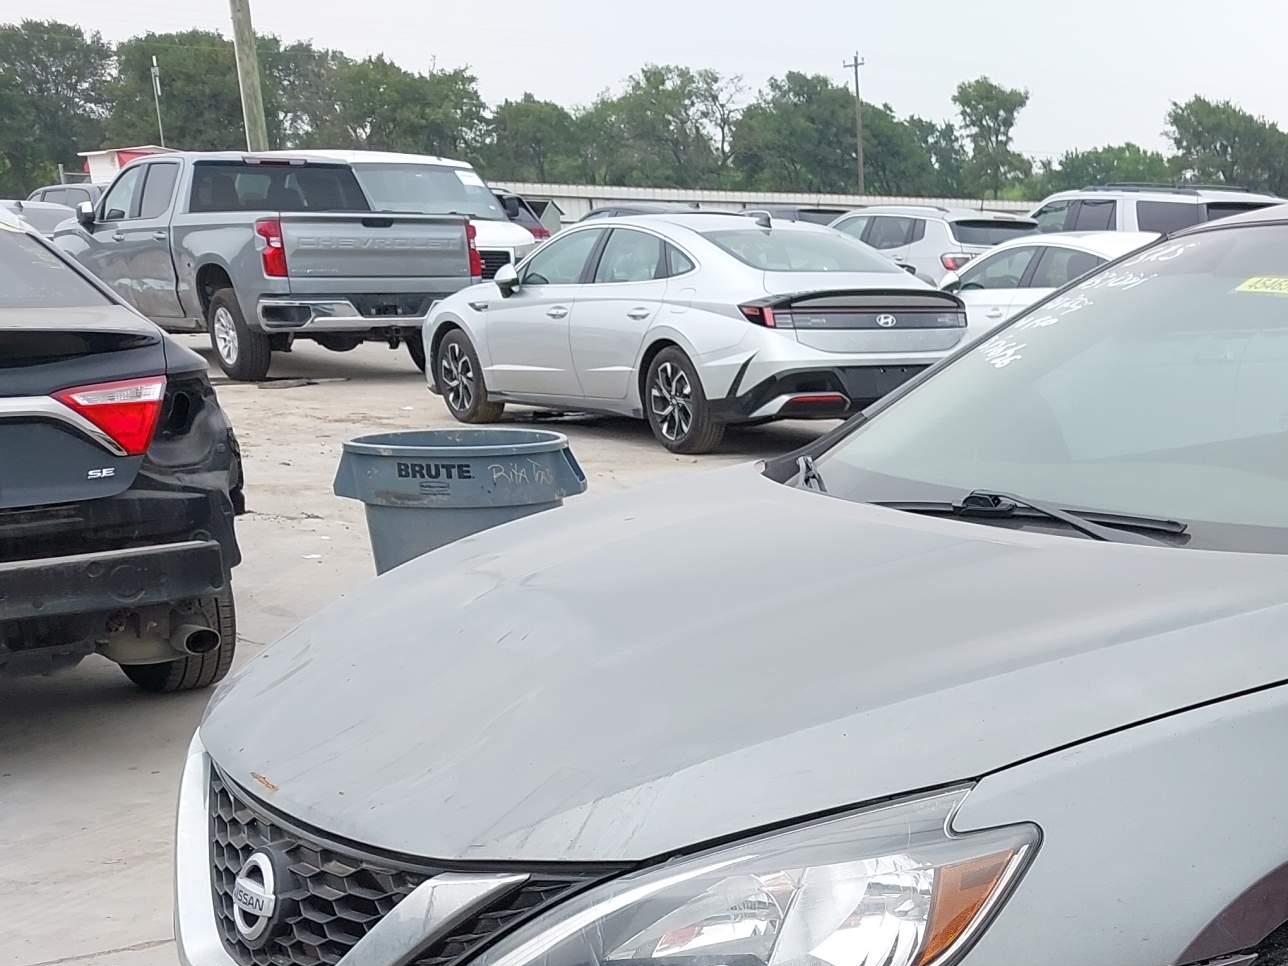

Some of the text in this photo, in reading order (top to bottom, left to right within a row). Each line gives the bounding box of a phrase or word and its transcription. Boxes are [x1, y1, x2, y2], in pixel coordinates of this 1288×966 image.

[298, 236, 459, 250] CHEVROLET
[87, 467, 116, 480] SE
[397, 462, 472, 480] BRUTE
